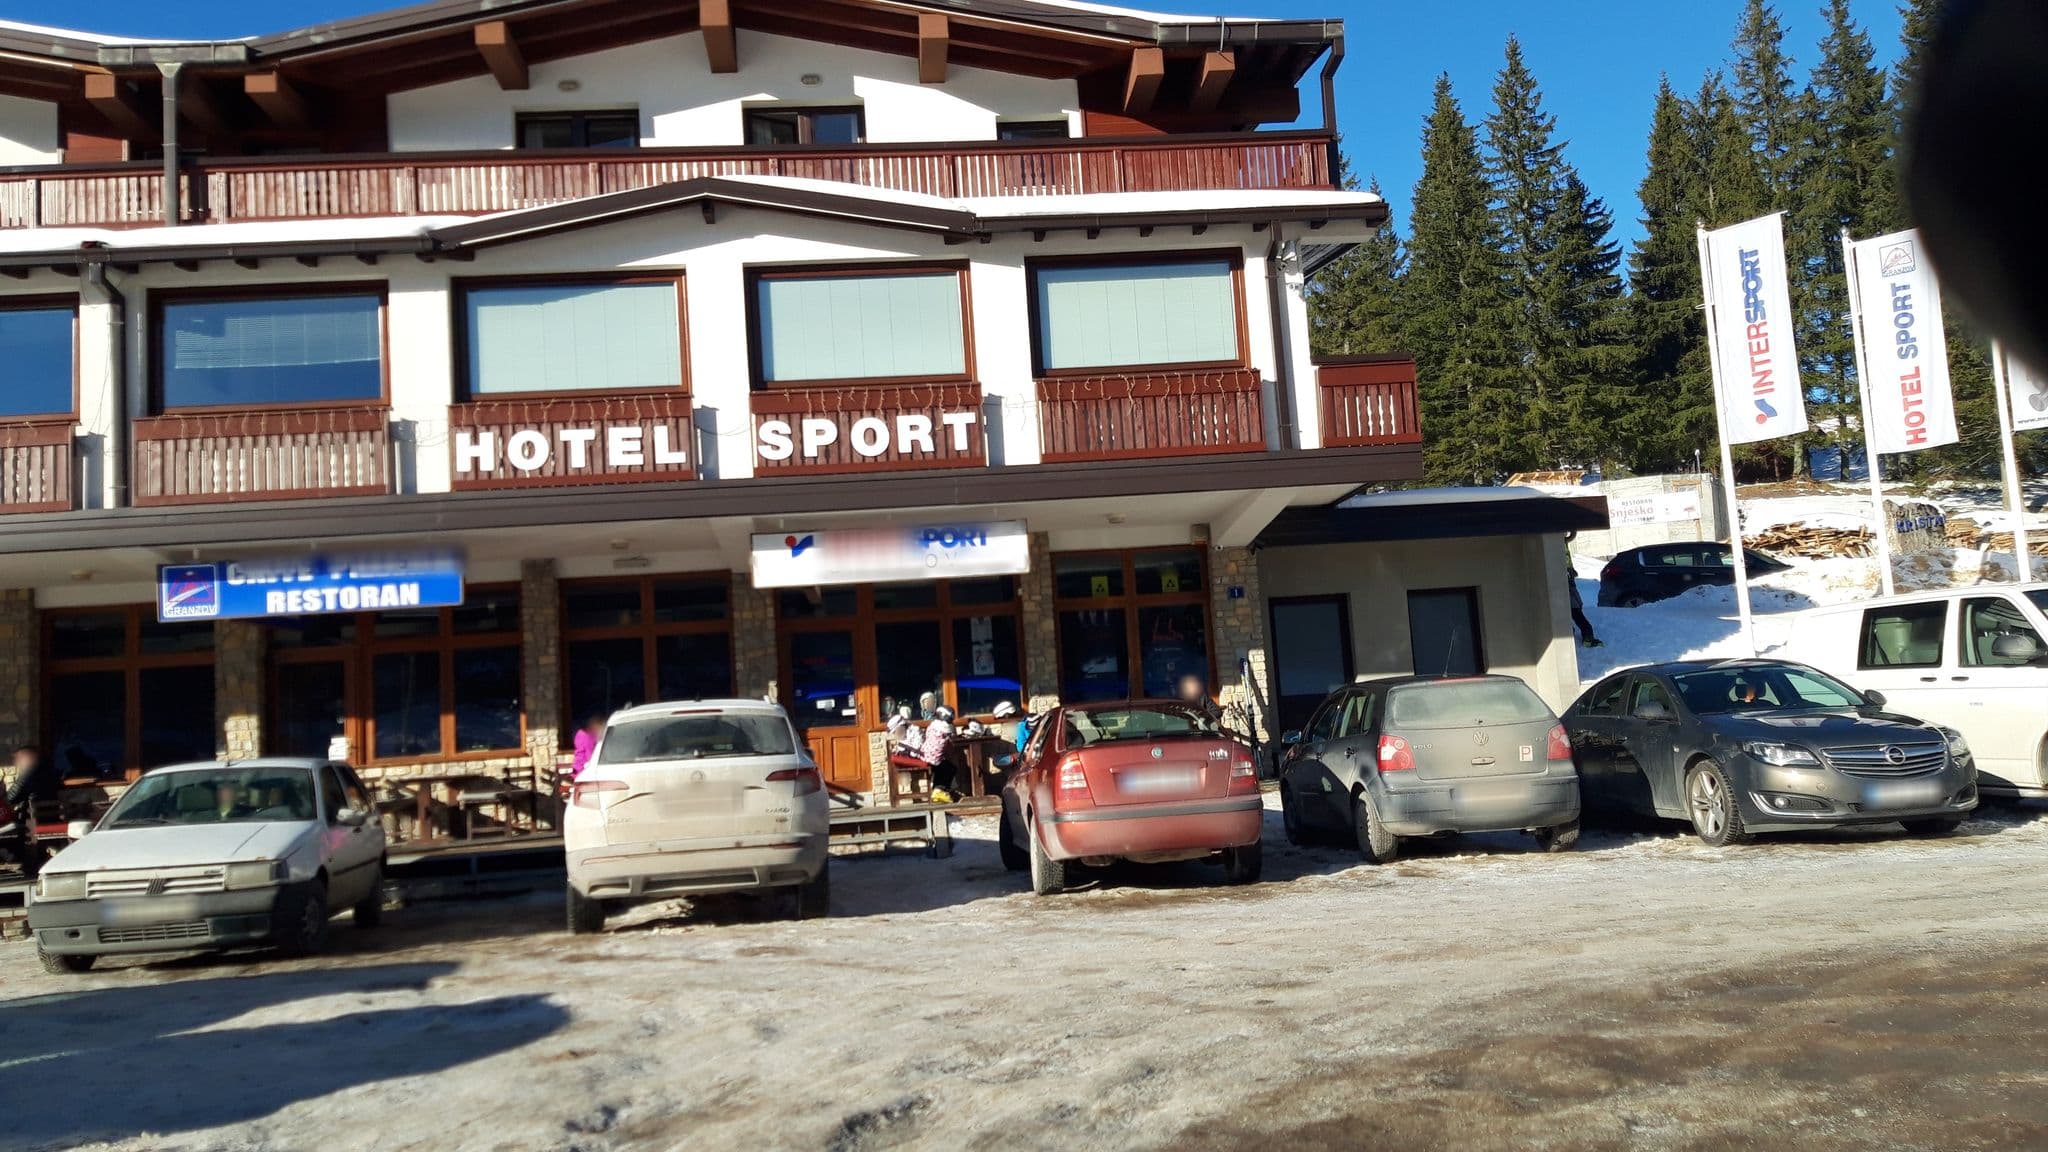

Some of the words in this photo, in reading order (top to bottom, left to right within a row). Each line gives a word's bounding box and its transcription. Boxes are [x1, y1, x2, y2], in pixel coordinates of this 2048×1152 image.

[1738, 248, 1776, 396] INTERSPORT
[1890, 282, 1919, 360] SPORT
[455, 425, 688, 473] HOTEL
[757, 412, 978, 461] SPORT
[1899, 365, 1928, 446] HOTEL
[266, 583, 420, 613] RESTORAN
